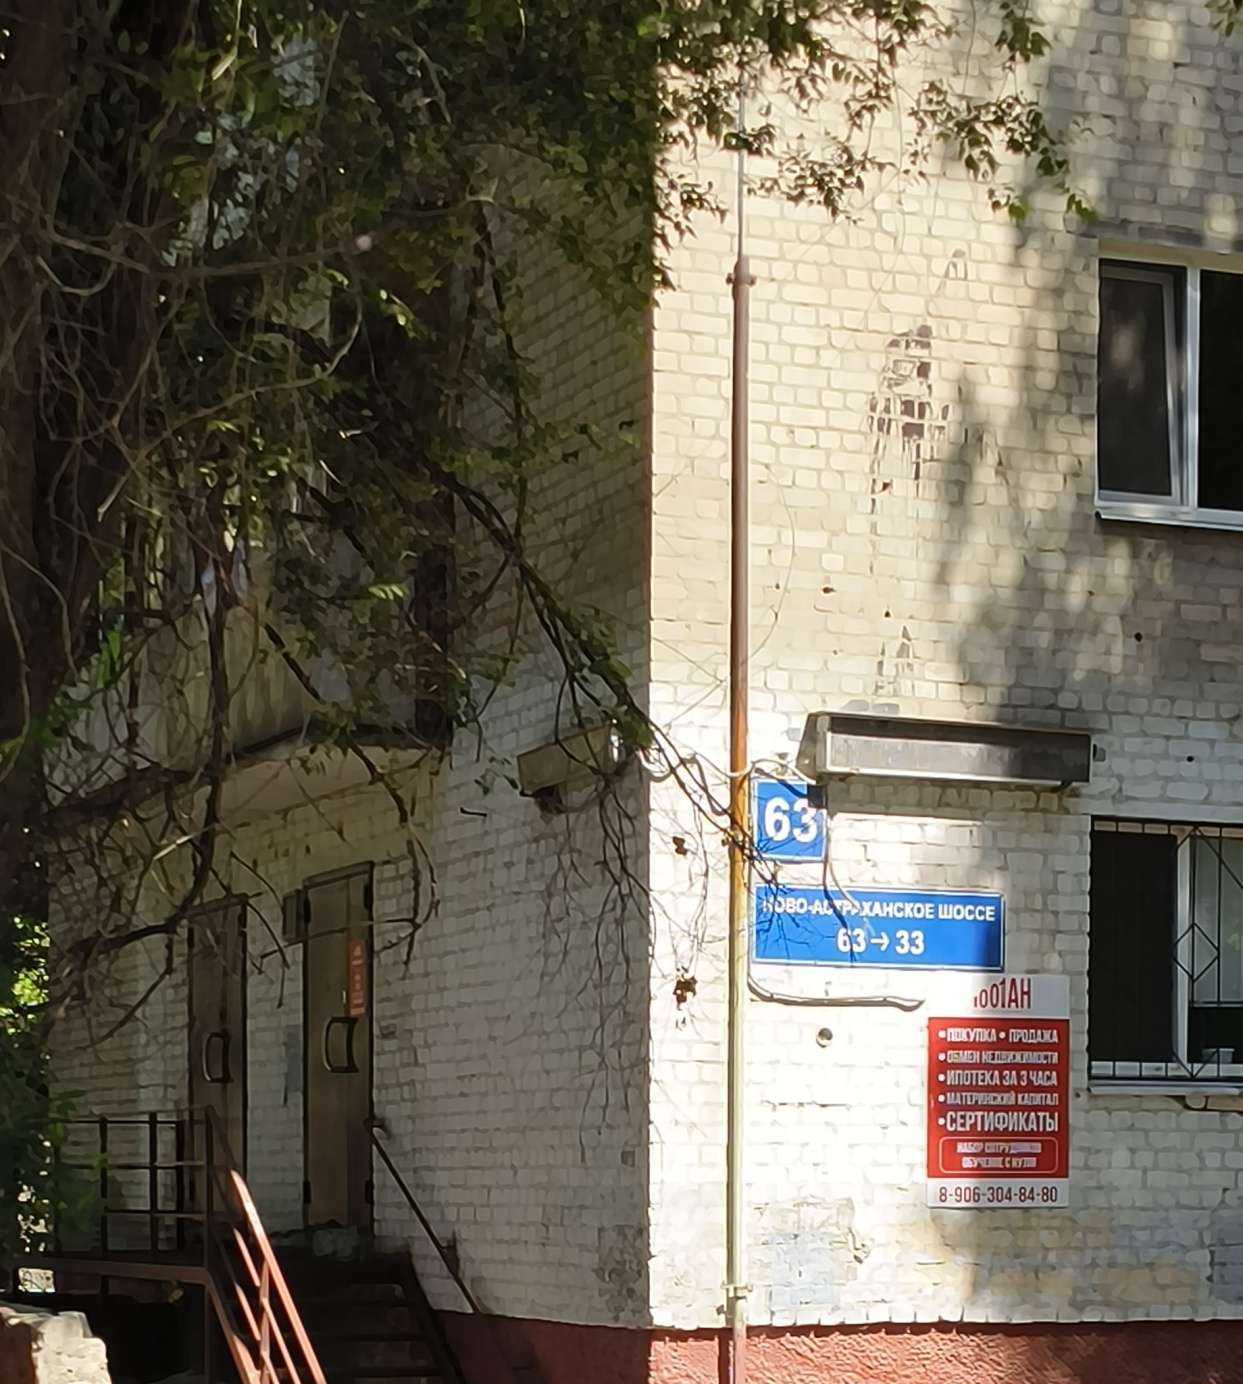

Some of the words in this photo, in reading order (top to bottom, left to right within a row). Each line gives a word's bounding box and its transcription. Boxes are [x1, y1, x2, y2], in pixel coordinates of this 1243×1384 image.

[764, 797, 818, 842] 63
[938, 904, 996, 922] ШОССЕ
[837, 927, 867, 953] 63
[895, 929, 926, 955] 33
[946, 1028, 997, 1042] ПОКУПКА
[1008, 1029, 1059, 1043] ПРОДАЖА
[946, 1070, 1000, 1085] ИПОТЕКА
[1002, 1071, 1018, 1085] ЗА
[1020, 1071, 1028, 1086] 3
[1029, 1071, 1058, 1086] ЧАСА
[946, 1091, 1016, 1105] МАТЕРИНСКИЙ
[1017, 1093, 1059, 1106] КАПИТАЛ
[945, 1111, 1059, 1132] СЕРТИФИКАТЫ
[961, 1157, 1004, 1168] ОУЧЕЕ
[1012, 1157, 1037, 1168] НУЛ
[939, 1186, 1059, 1203] 8-906-304-84-80
